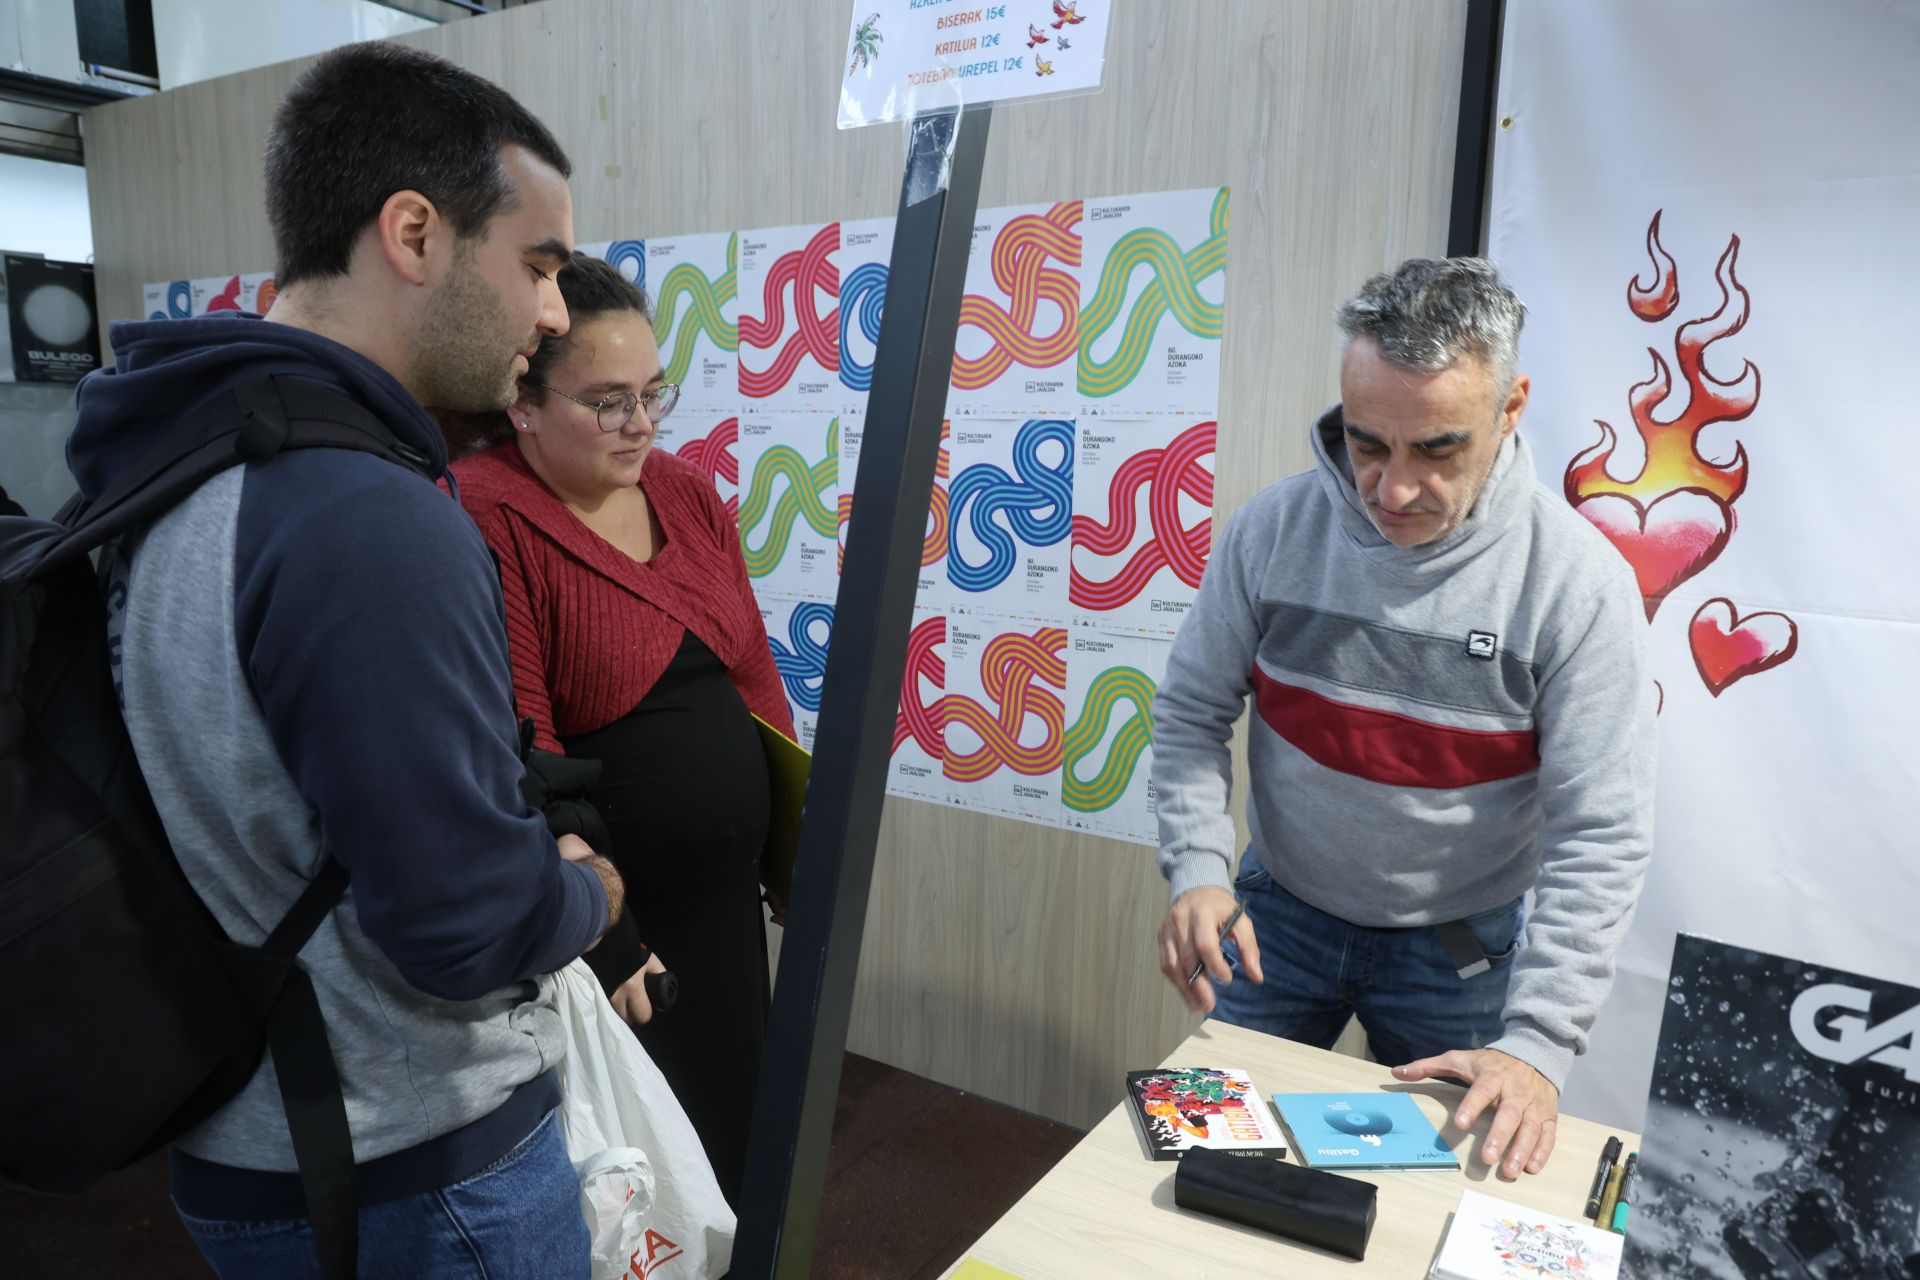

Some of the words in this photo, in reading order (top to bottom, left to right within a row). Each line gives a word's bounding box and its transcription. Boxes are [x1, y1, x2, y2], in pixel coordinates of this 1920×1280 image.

[937, 9, 982, 29] BISERAK
[986, 5, 1006, 20] 15€
[935, 37, 977, 56] KATILUA
[981, 33, 1000, 48] 12€
[959, 60, 999, 78] UREPEL
[1003, 56, 1024, 71] 12€
